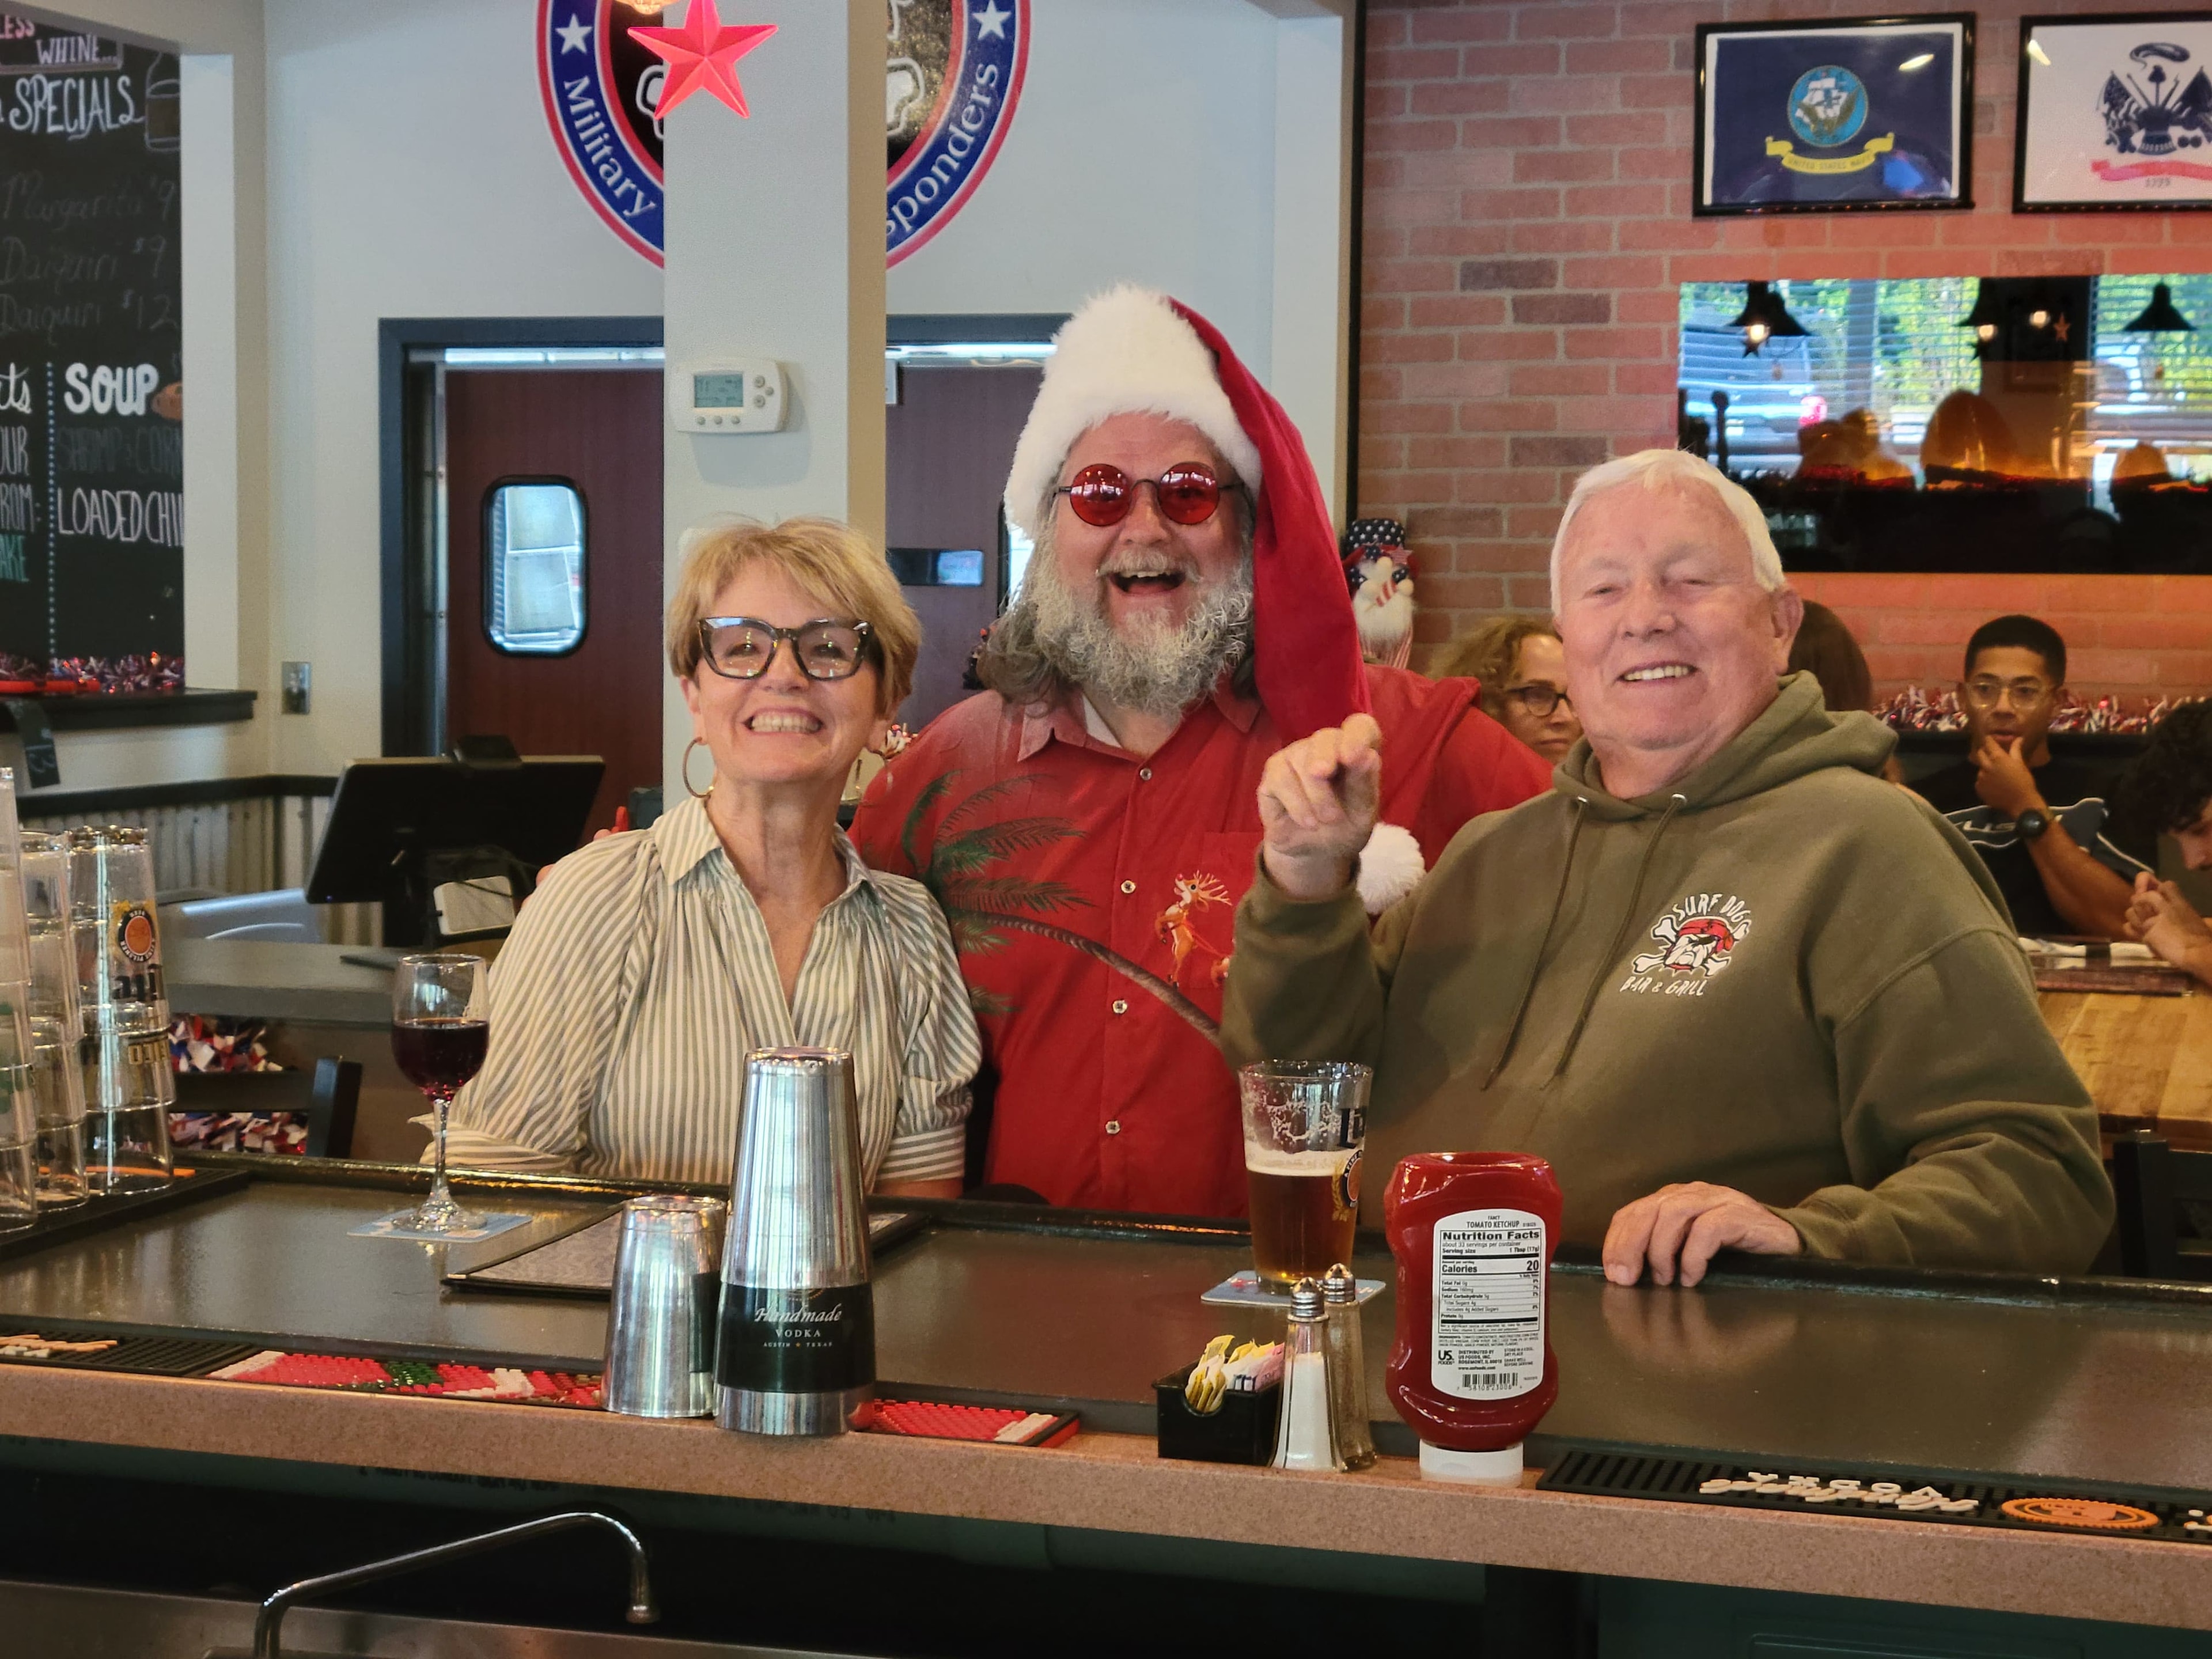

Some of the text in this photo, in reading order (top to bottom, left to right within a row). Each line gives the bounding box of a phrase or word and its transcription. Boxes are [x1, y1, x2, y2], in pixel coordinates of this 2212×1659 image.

[0, 9, 35, 39] ESS
[9, 73, 143, 141] SPECIALS
[563, 75, 657, 217] Military
[64, 362, 160, 416] SOUP
[0, 483, 42, 533] ROM:
[58, 487, 143, 543] LOADED
[1672, 893, 1751, 923] SURF DOG
[1619, 976, 1707, 997] BAR & GRILL
[1442, 1230, 1540, 1240] Nutrition Facts
[1442, 1260, 1539, 1273] Calories 20
[754, 1302, 842, 1323] Handmade
[775, 1328, 821, 1338] VODKA
[1438, 1350, 1453, 1361] US
